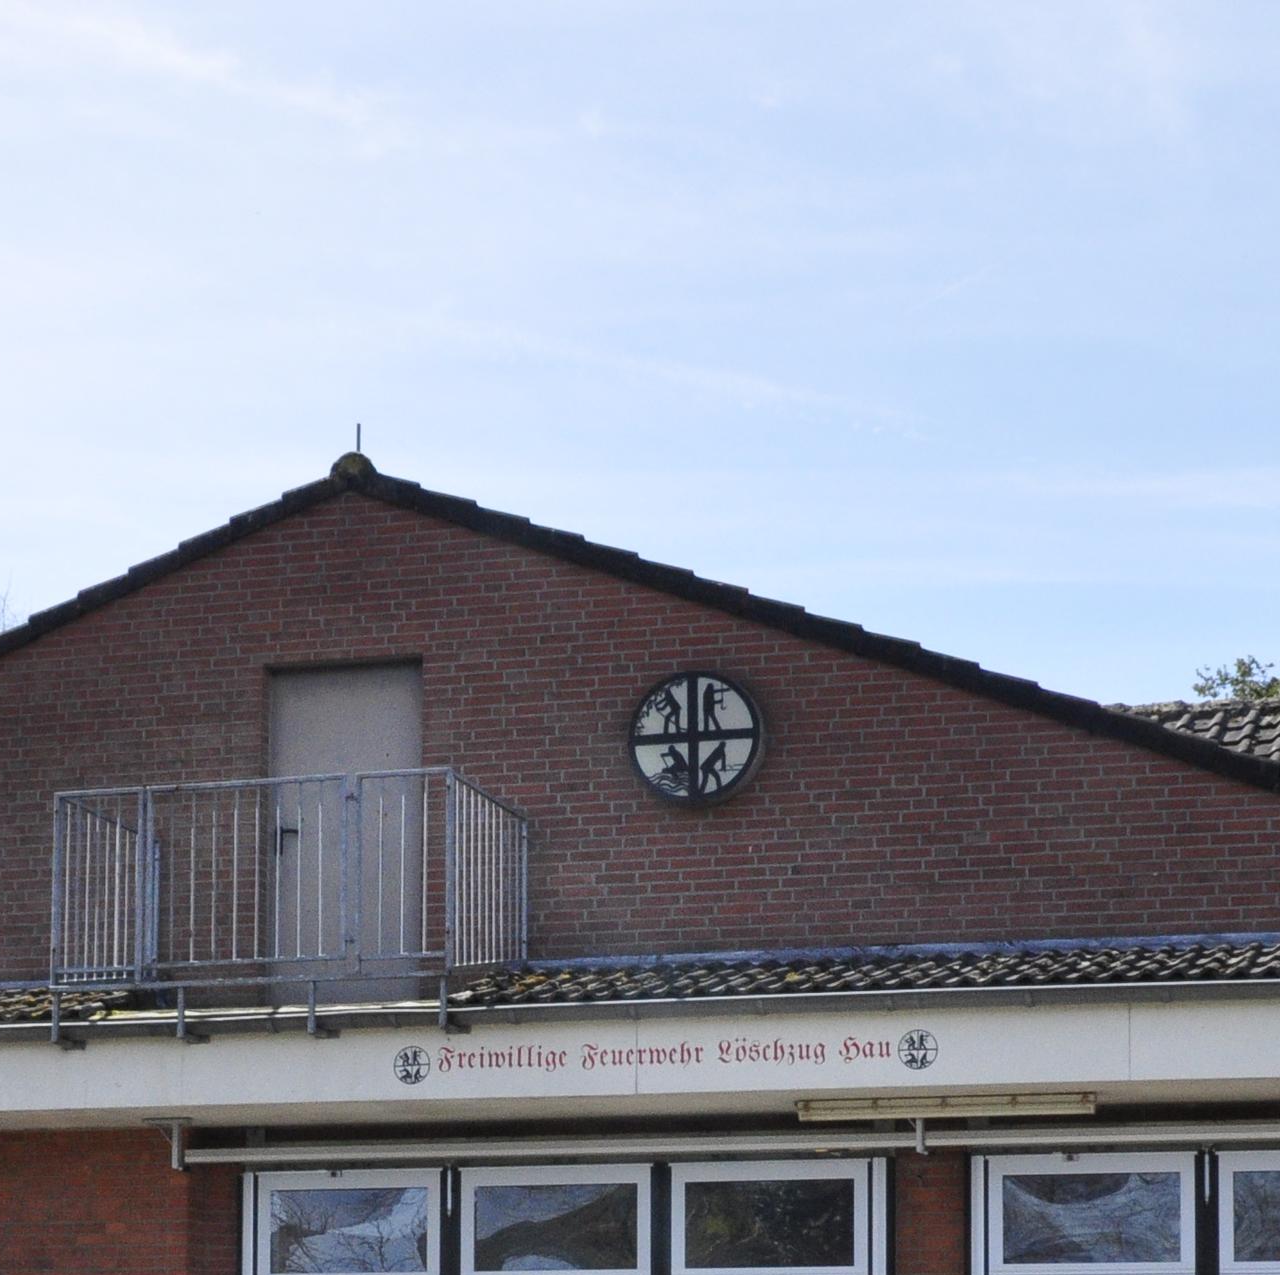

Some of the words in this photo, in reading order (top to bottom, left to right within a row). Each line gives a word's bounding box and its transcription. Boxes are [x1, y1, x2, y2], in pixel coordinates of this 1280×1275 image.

[438, 1044, 568, 1073] Freiwillige
[581, 1041, 705, 1070] Feuerwehr
[718, 1037, 826, 1065] Löschzug
[838, 1036, 892, 1063] Hau
